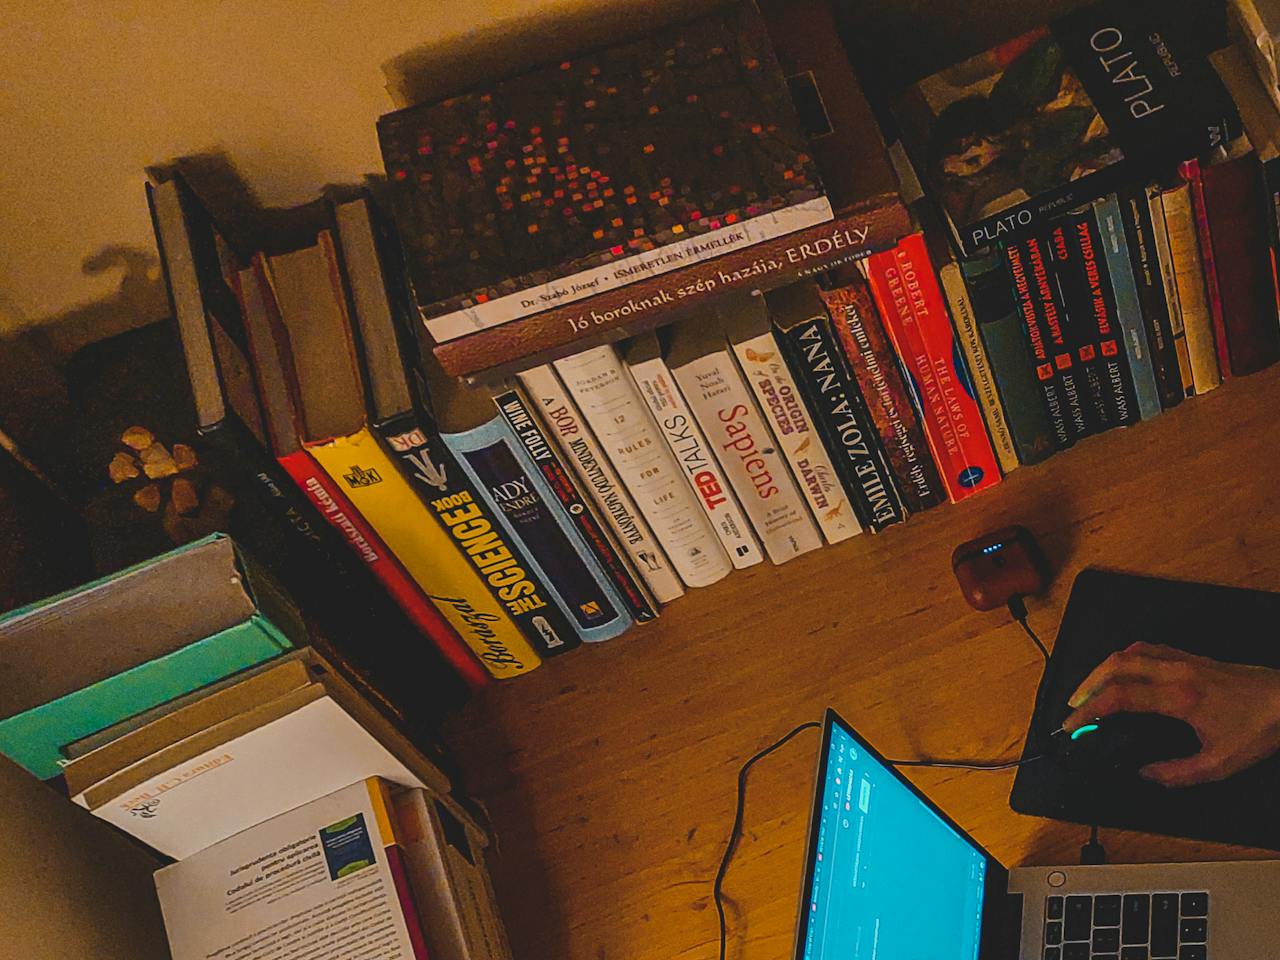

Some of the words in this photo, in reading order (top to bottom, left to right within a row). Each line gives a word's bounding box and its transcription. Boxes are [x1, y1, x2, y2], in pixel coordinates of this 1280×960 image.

[1090, 28, 1165, 118] PLATO
[972, 209, 1032, 246] PLATO
[1053, 226, 1070, 262] CSABA
[1077, 221, 1097, 261] CSILLAG
[519, 297, 536, 310] Dr.
[540, 289, 569, 303] Szabó
[571, 277, 600, 298] József
[613, 249, 683, 280] ISMERETLEN
[685, 231, 744, 258] ÉRMELLÉK
[567, 315, 588, 333] Jó
[590, 291, 674, 326] boroknak
[676, 277, 716, 302] szép
[719, 258, 783, 287] hazája,
[786, 225, 870, 264] ERDÉLY
[902, 261, 929, 318] ROBERT
[1026, 238, 1053, 302] ÁRNYÉKÁBAN
[1083, 259, 1101, 289] VERES
[884, 266, 914, 327] GREENE
[1022, 299, 1038, 326] VISSZA
[1092, 296, 1112, 336] ELVÁSIK
[1043, 300, 1063, 337] KASTÉLY
[799, 324, 841, 395] NANA
[1107, 361, 1125, 395] ALBERT
[758, 379, 795, 436] SPECIES
[778, 385, 810, 434] ORIGIN
[915, 353, 940, 404] HUMAN
[934, 404, 959, 456] NATURE
[934, 357, 949, 386] THE
[945, 387, 962, 421] LAWS
[957, 422, 969, 439] OF
[1043, 383, 1062, 417] ALBERT
[1062, 374, 1080, 407] ALBERT
[1114, 392, 1129, 422] WASS
[502, 399, 528, 432] WINE
[520, 428, 553, 462] FOLLY
[830, 392, 871, 462] ZOLA:
[1068, 405, 1086, 433] WASS
[541, 397, 555, 407] A
[548, 406, 579, 438] BOR
[568, 437, 615, 498] MINDENTUDÓ
[617, 438, 653, 455] RULES
[664, 414, 709, 476] TALKS
[718, 404, 780, 500] Sapiens
[492, 476, 532, 502] ADY
[639, 466, 661, 480] FOR
[693, 471, 728, 511] TED
[797, 458, 830, 509] DARWIN
[854, 459, 897, 525] ÉMILE
[430, 489, 473, 513] BOOK
[500, 493, 540, 513] ENDRE
[653, 491, 676, 506] LIFE
[440, 502, 537, 601] SCIENCE
[505, 594, 548, 617] THE
